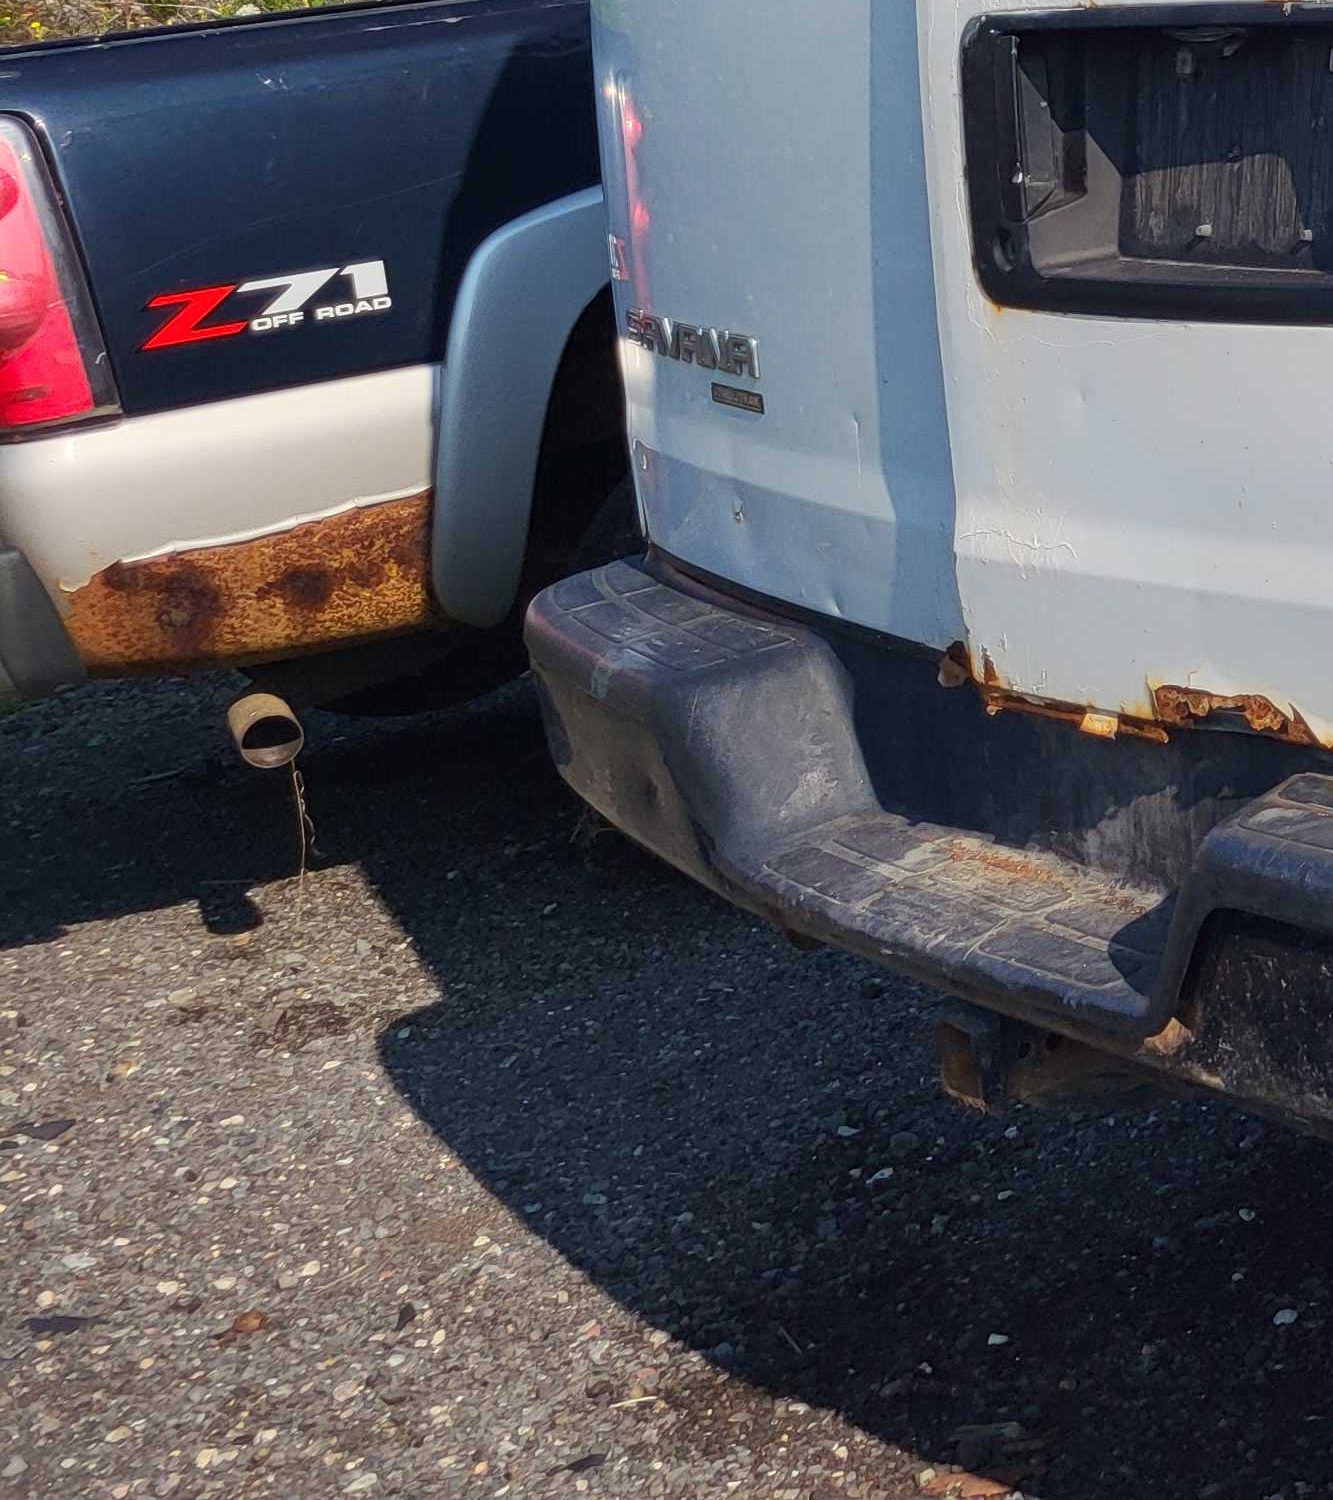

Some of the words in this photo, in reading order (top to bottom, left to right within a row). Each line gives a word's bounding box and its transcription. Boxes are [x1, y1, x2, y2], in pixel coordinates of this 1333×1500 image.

[141, 259, 389, 351] Z71
[251, 310, 305, 333] OFF
[316, 295, 393, 321] ROAD
